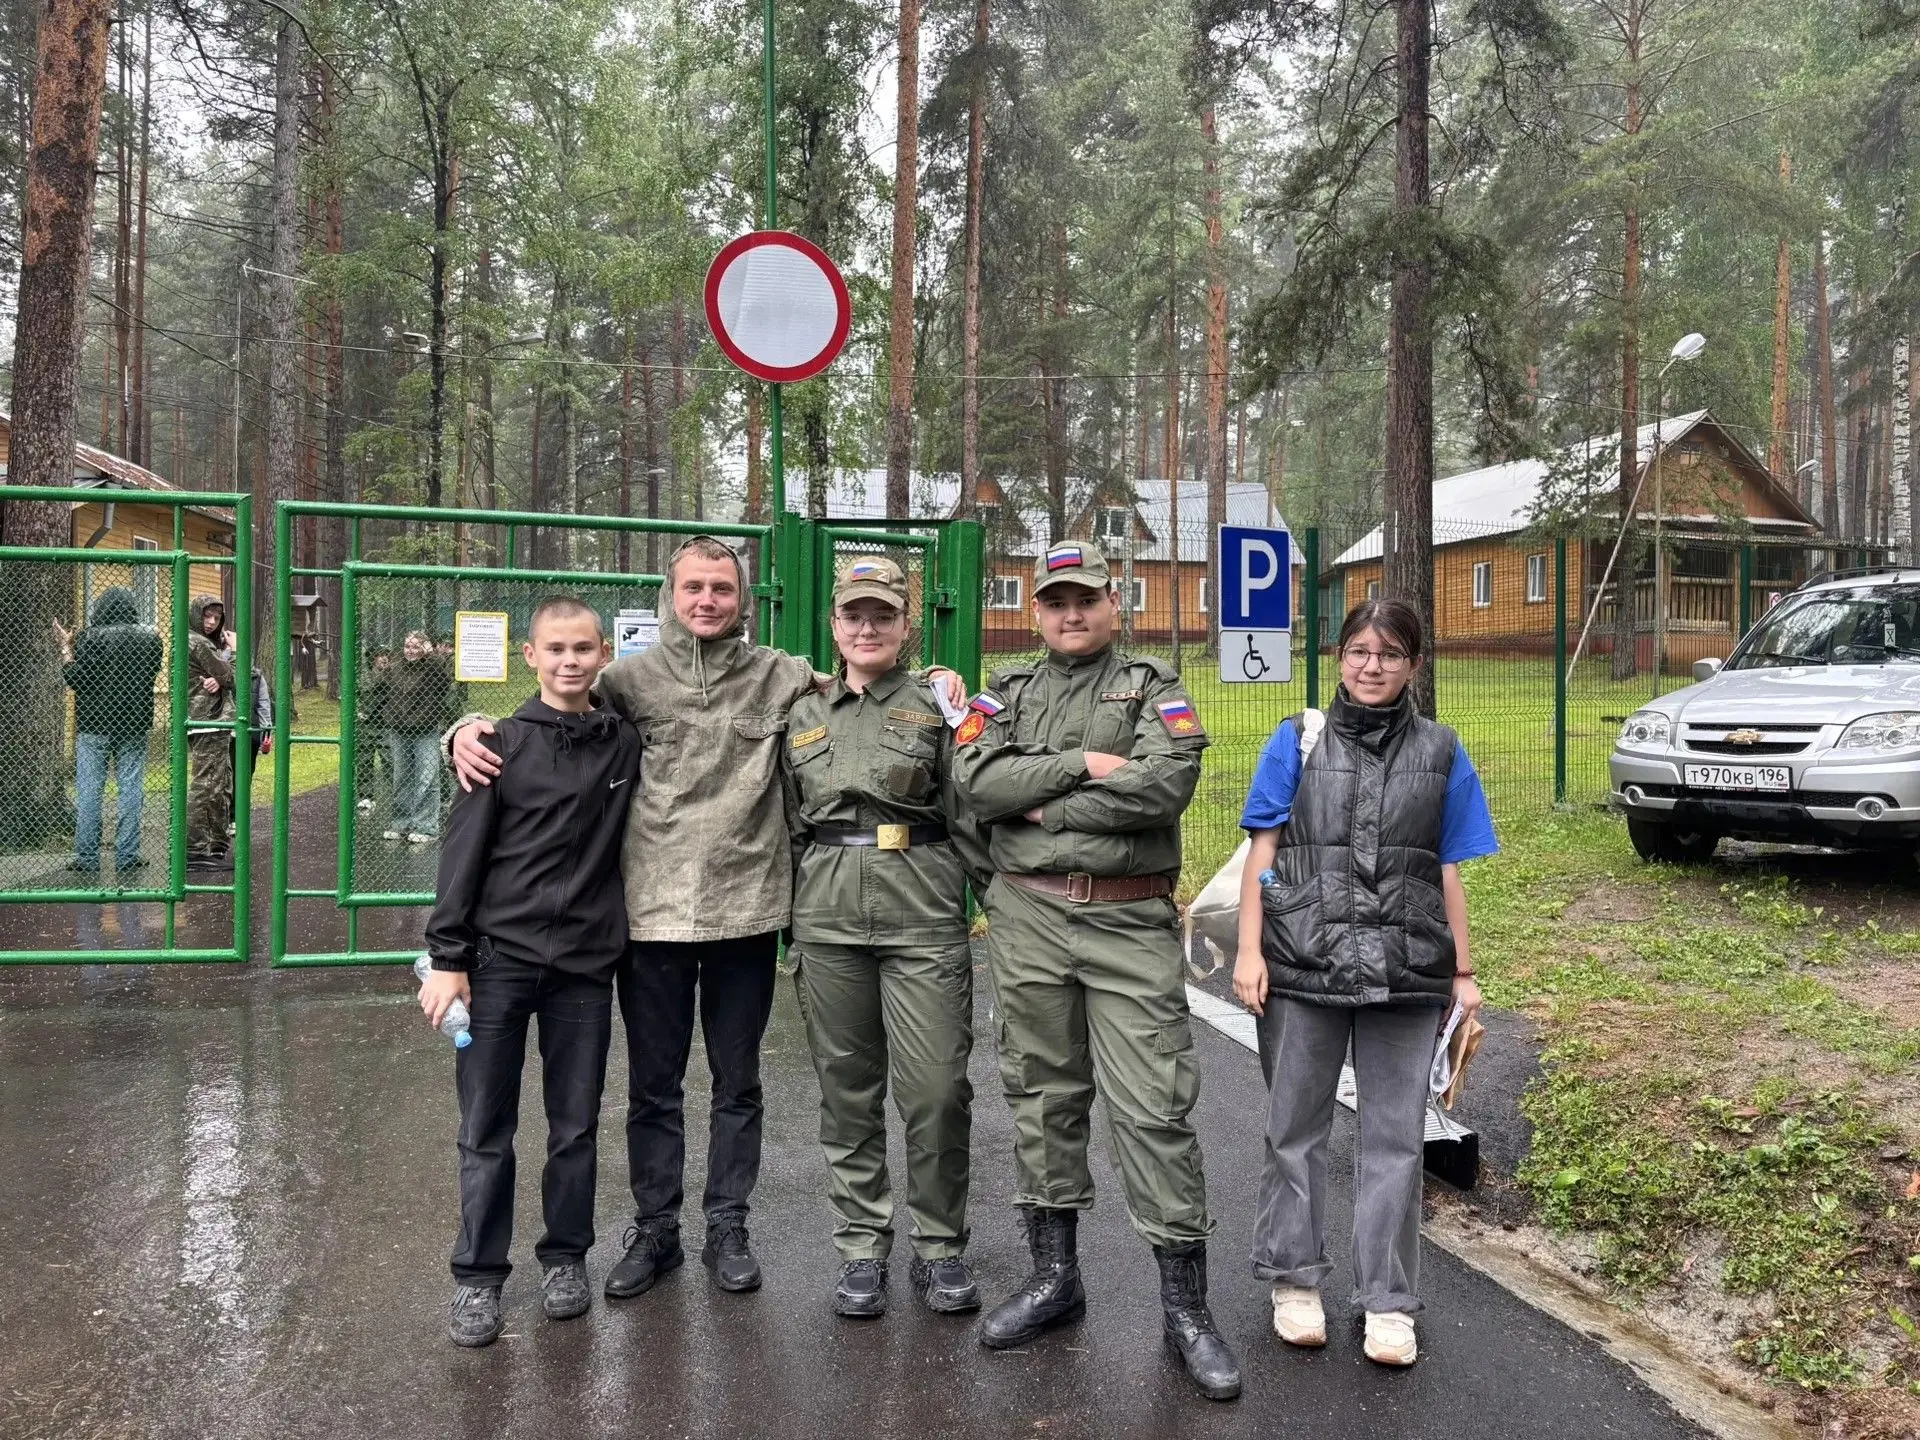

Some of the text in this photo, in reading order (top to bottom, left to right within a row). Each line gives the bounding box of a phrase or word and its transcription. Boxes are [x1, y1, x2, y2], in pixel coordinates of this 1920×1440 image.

[1241, 538, 1278, 617] P
[905, 712, 927, 722] ЗАРЯ
[1758, 768, 1784, 781] 196
